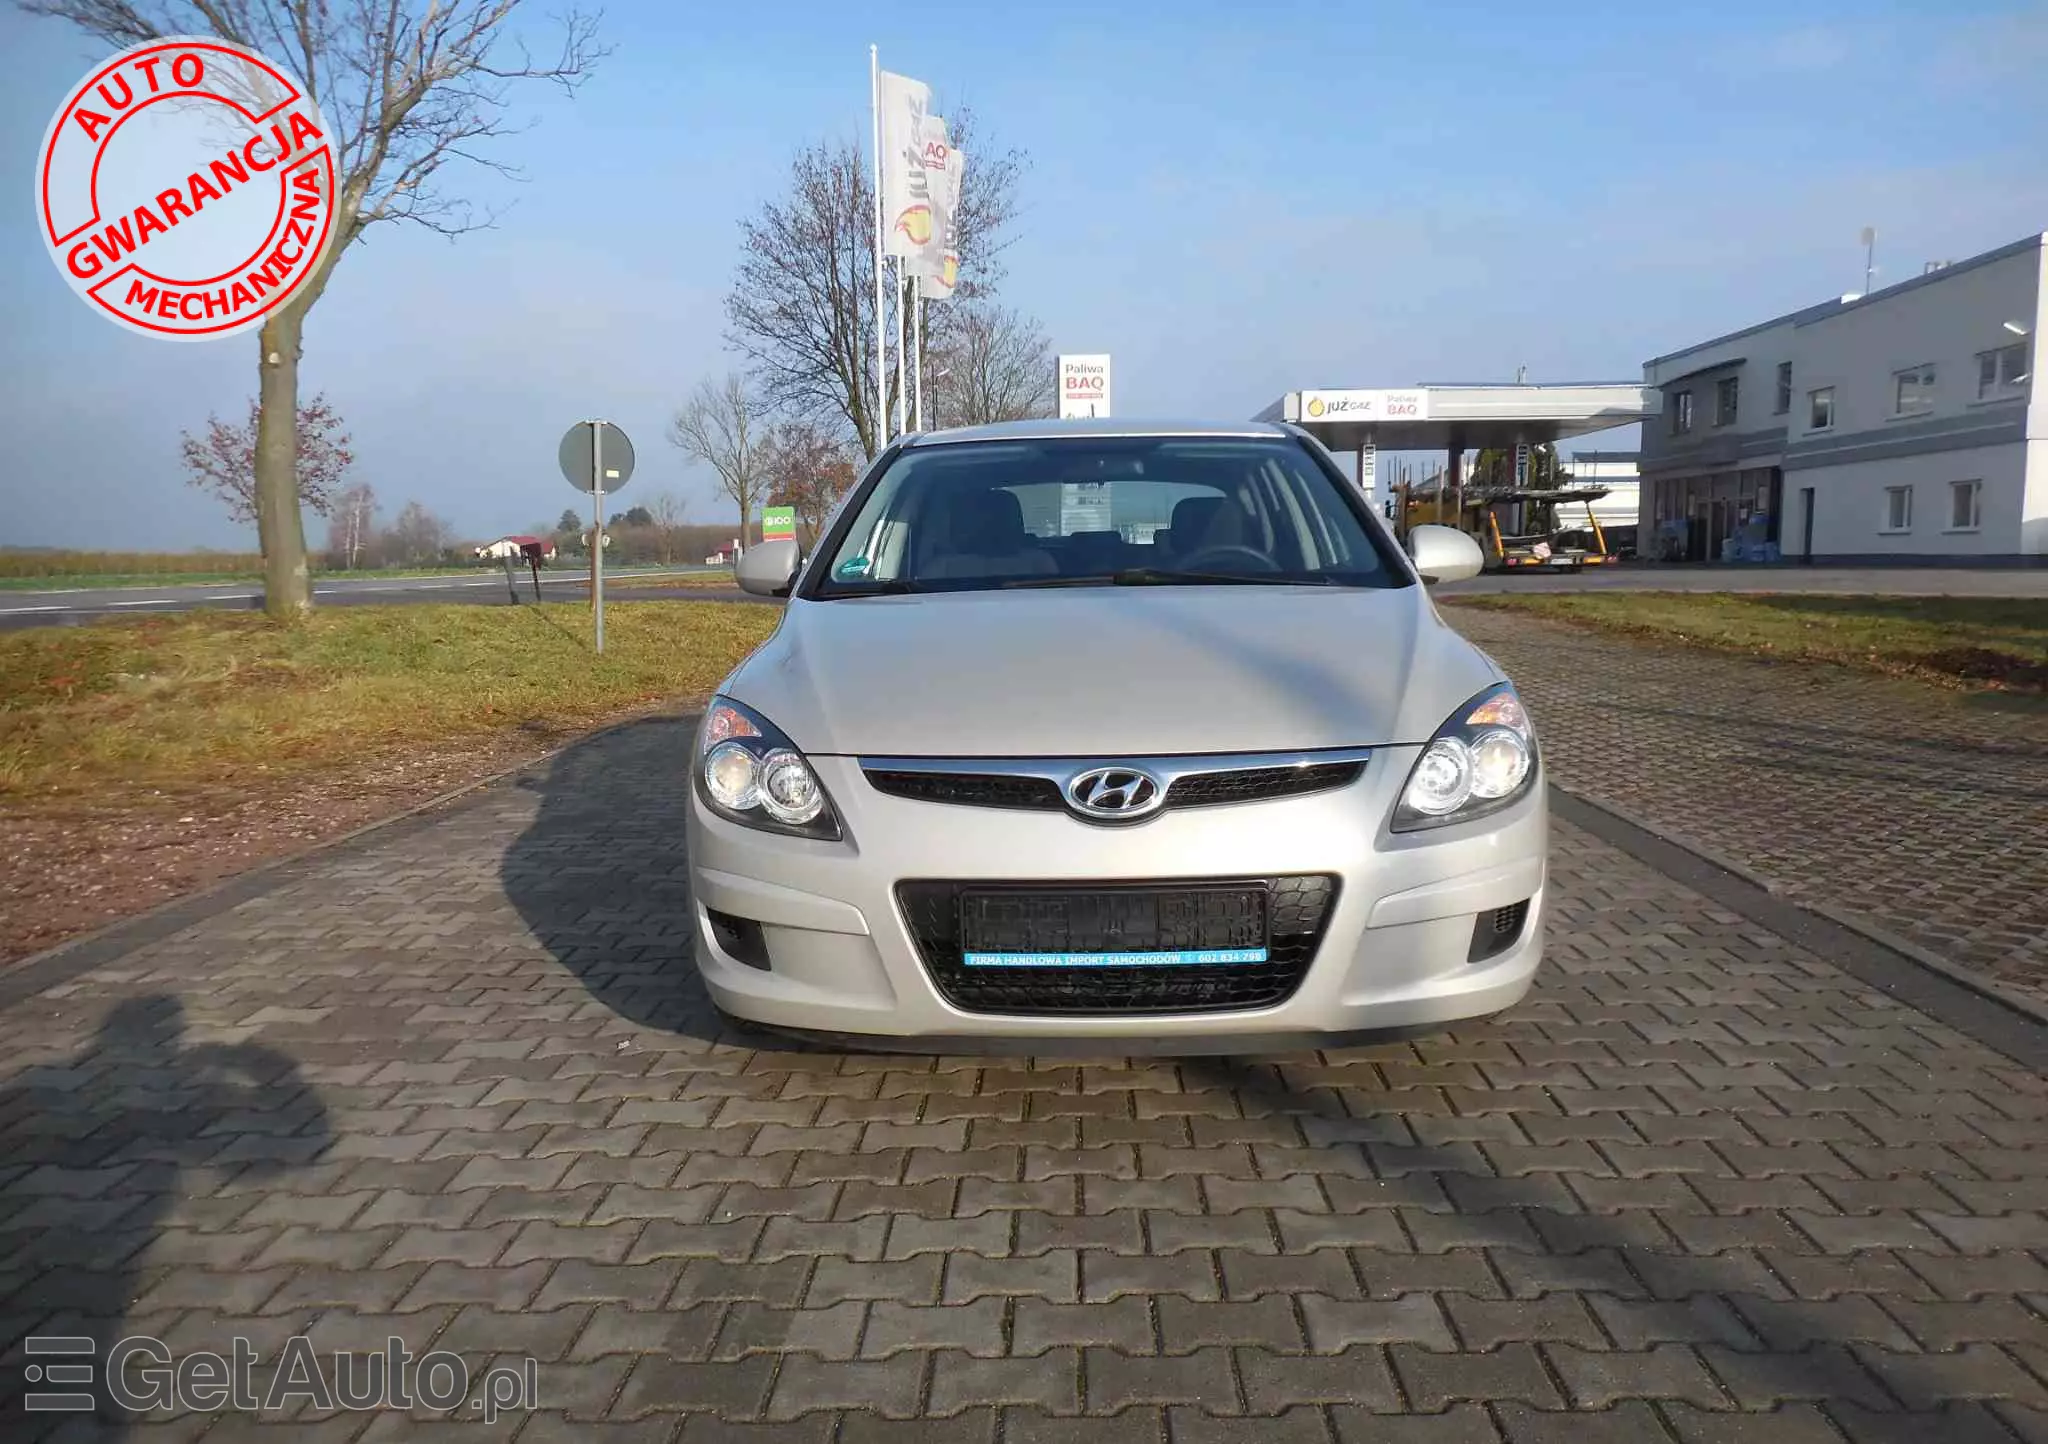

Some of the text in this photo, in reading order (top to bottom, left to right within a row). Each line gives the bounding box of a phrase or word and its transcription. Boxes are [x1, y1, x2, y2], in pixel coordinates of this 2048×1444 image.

[925, 142, 946, 161] AQ
[1065, 363, 1104, 374] Paliwa
[1066, 376, 1104, 391] BAQ
[1387, 404, 1417, 416] BAQ
[970, 956, 1002, 965] FIRMA
[1004, 956, 1062, 965] HANDLOWA
[1065, 955, 1105, 965] IMPORT
[1199, 953, 1216, 962] 602
